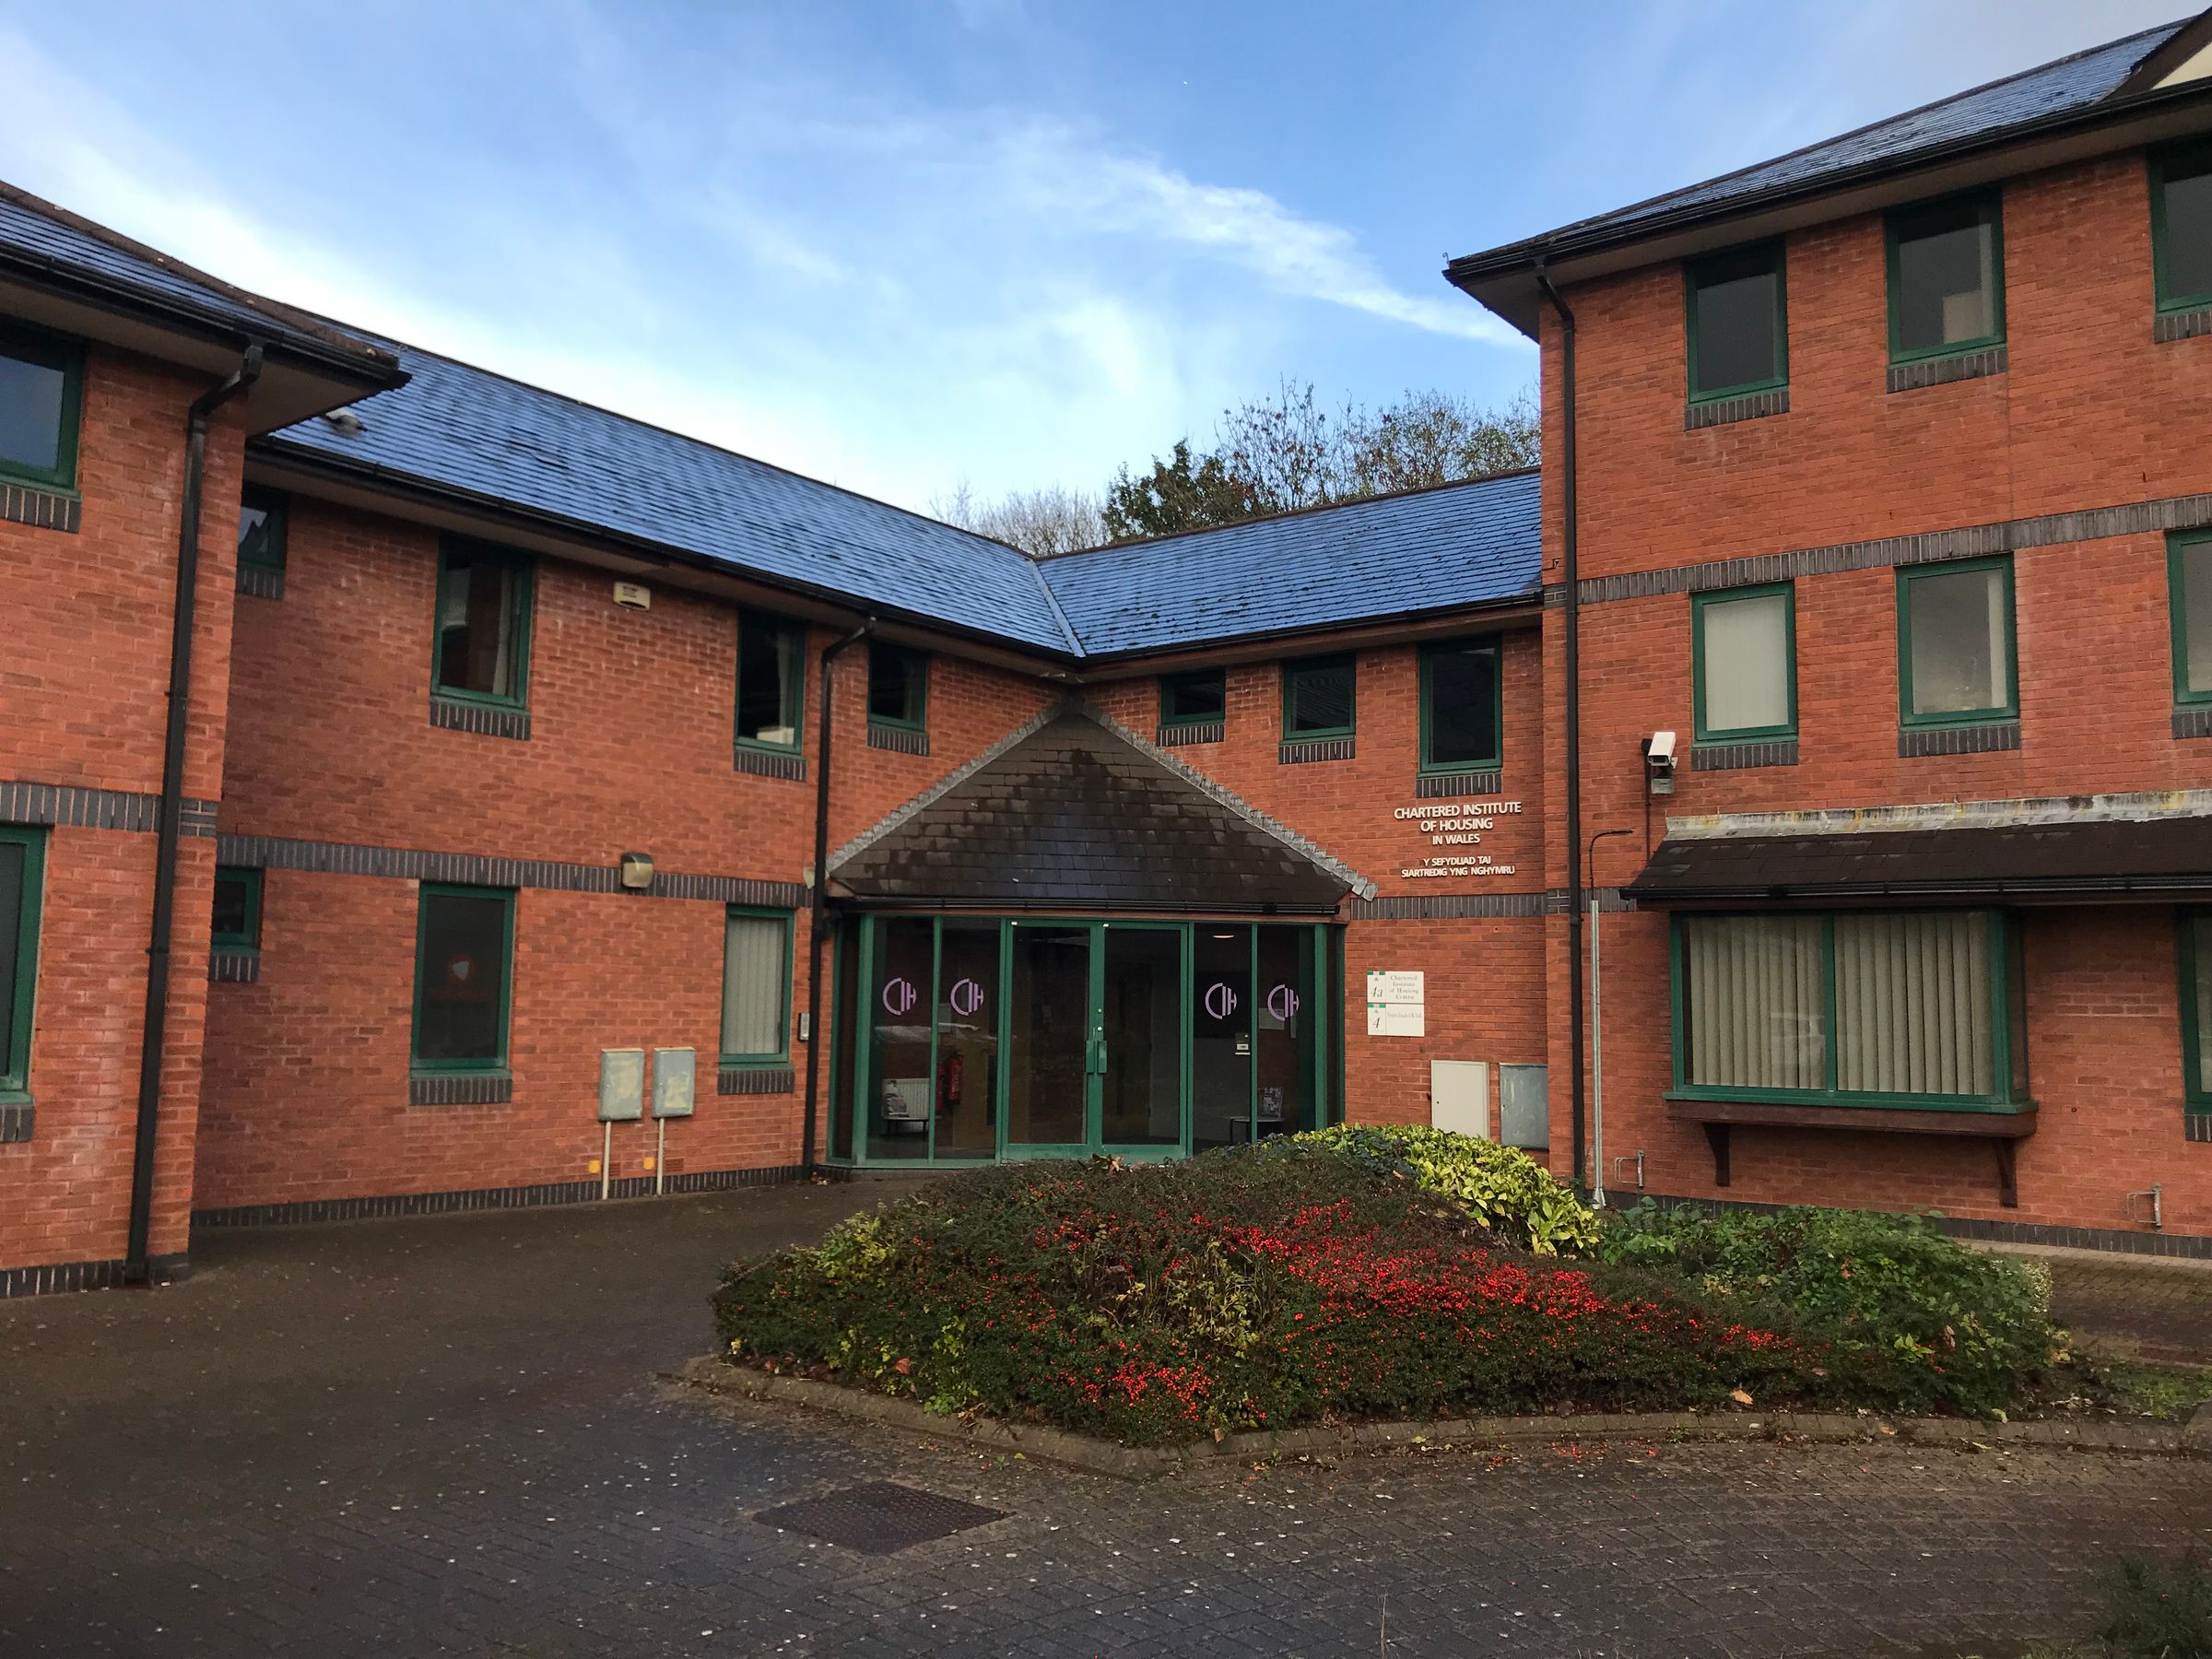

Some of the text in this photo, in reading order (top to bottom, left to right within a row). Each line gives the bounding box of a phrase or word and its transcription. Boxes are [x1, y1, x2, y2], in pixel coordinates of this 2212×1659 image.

[1394, 802, 1522, 819] CHARTERED INSTITUTE
[1420, 818, 1493, 831] OF HOUSING
[1432, 833, 1480, 845] IN WALES
[1423, 855, 1491, 866] Y SEFYDLIAD TAI
[1401, 865, 1515, 877] SIARTREDIG YNG NGHYMRU
[1372, 1017, 1381, 1029] 4
